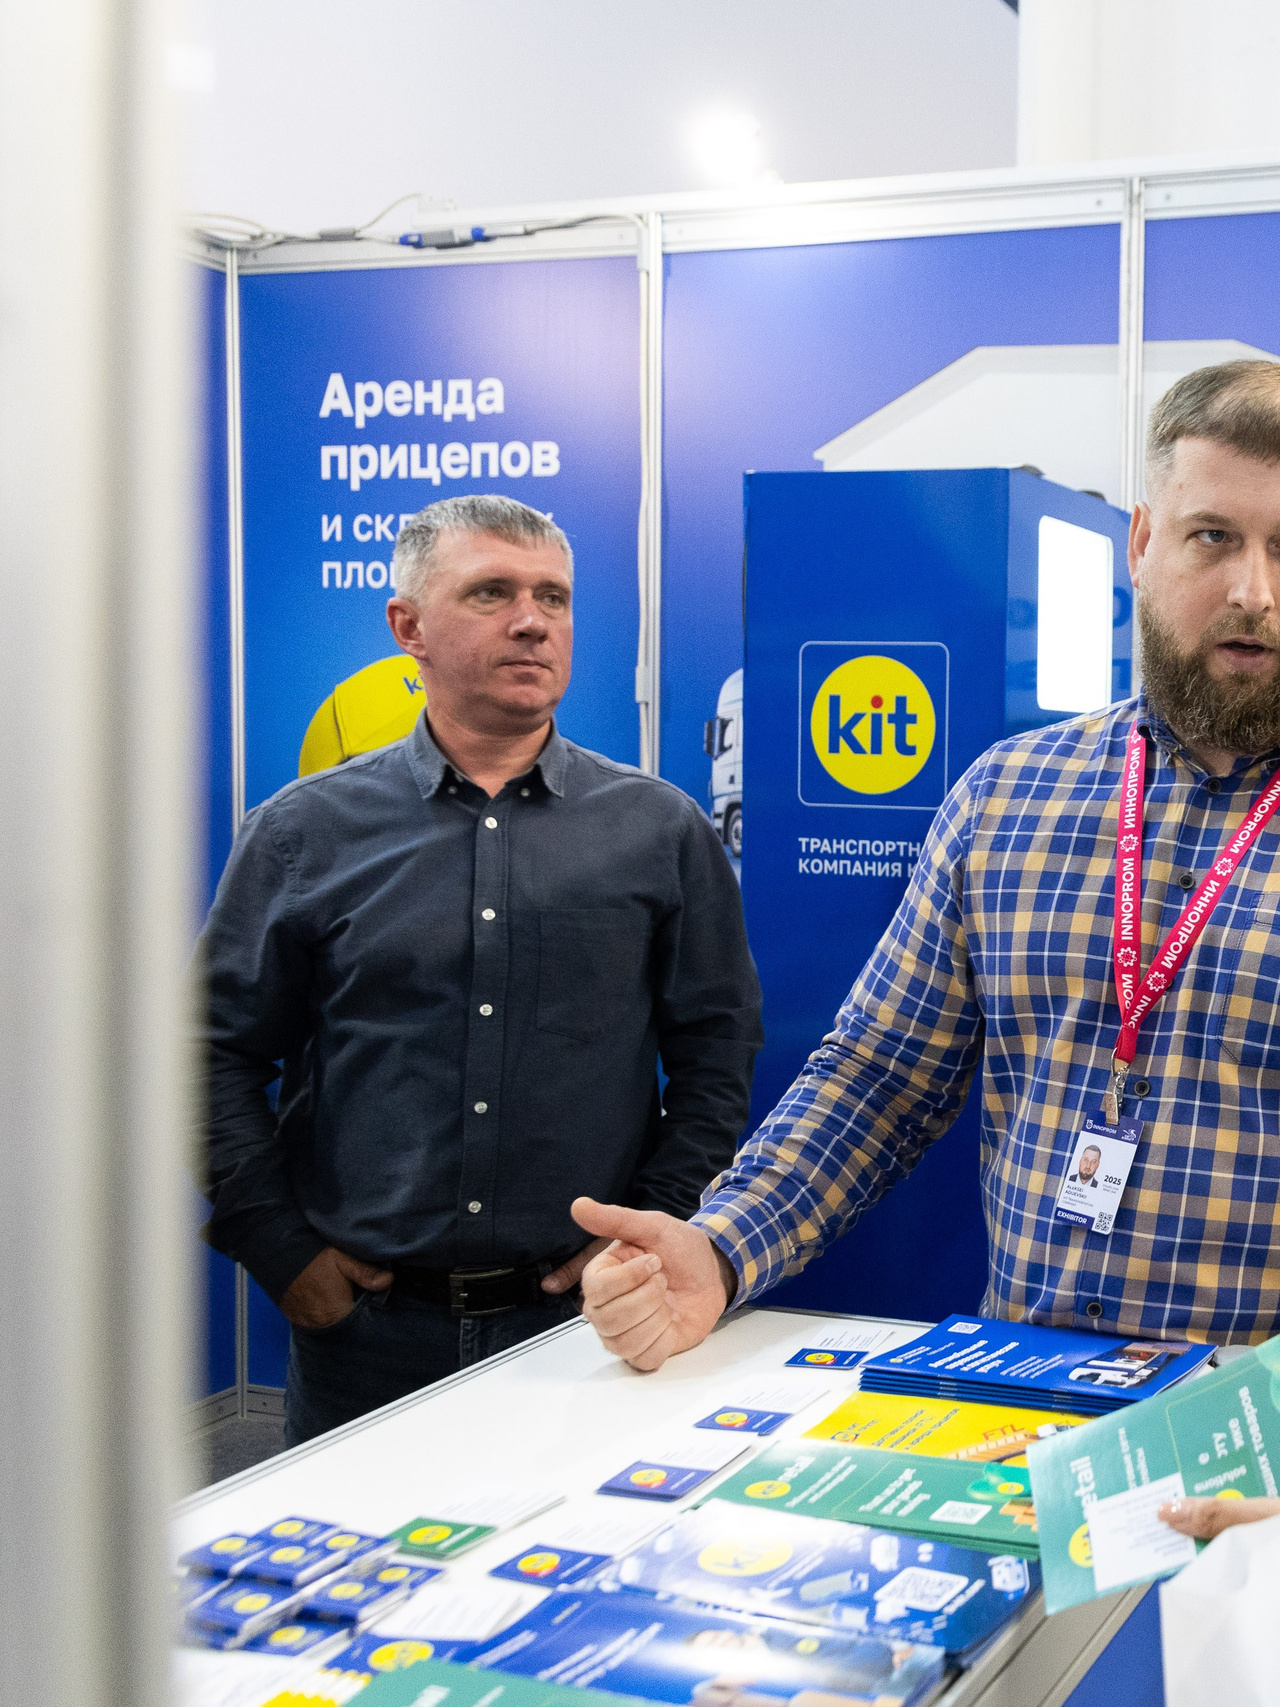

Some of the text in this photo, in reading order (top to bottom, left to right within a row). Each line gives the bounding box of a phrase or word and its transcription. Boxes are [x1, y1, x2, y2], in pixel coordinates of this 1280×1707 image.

[319, 372, 505, 429] Аренда
[320, 441, 561, 491] прицепов
[321, 514, 342, 542] и
[828, 694, 918, 757] kit
[1124, 747, 1140, 829] ИННОПРОМ
[798, 837, 922, 857] ТРАНСПОРТН
[798, 858, 902, 877] КОМПАНИЯ
[1121, 857, 1135, 940] INNOPROM
[1161, 880, 1221, 969] ИННОПРОМ
[1104, 1175, 1122, 1186] 2025
[1057, 1210, 1088, 1225] EXHIBITOR
[982, 1424, 1026, 1440] FTL
